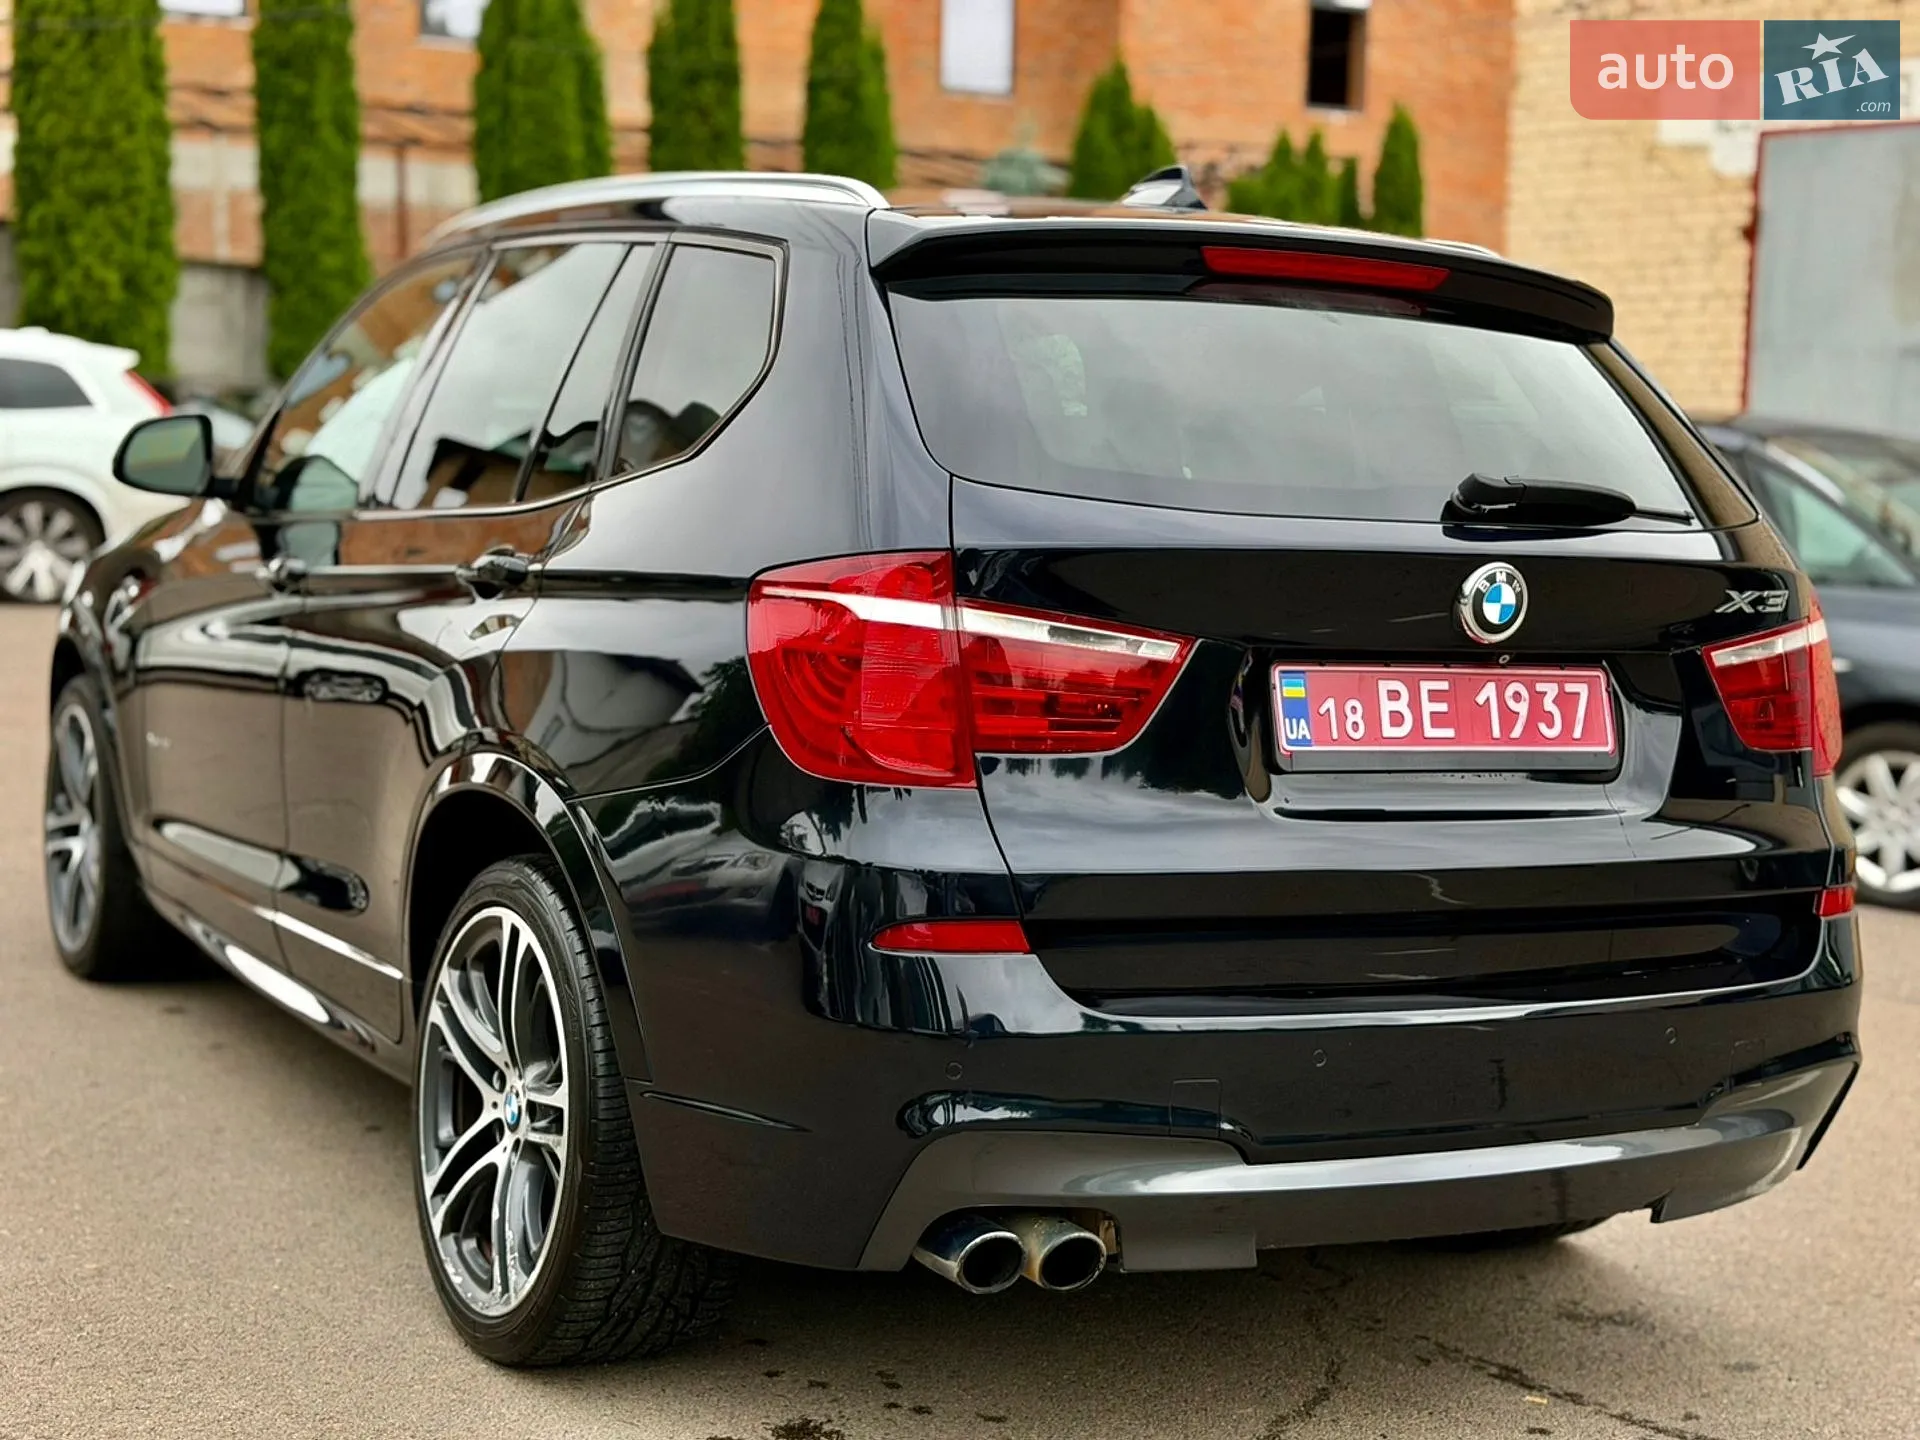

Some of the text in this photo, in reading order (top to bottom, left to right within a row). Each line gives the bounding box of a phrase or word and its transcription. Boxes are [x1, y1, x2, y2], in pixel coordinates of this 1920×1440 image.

[1477, 571, 1522, 593] BMW
[1714, 589, 1789, 613] X3
[1317, 679, 1590, 740] 18 BE 1937
[1285, 717, 1311, 740] UA
